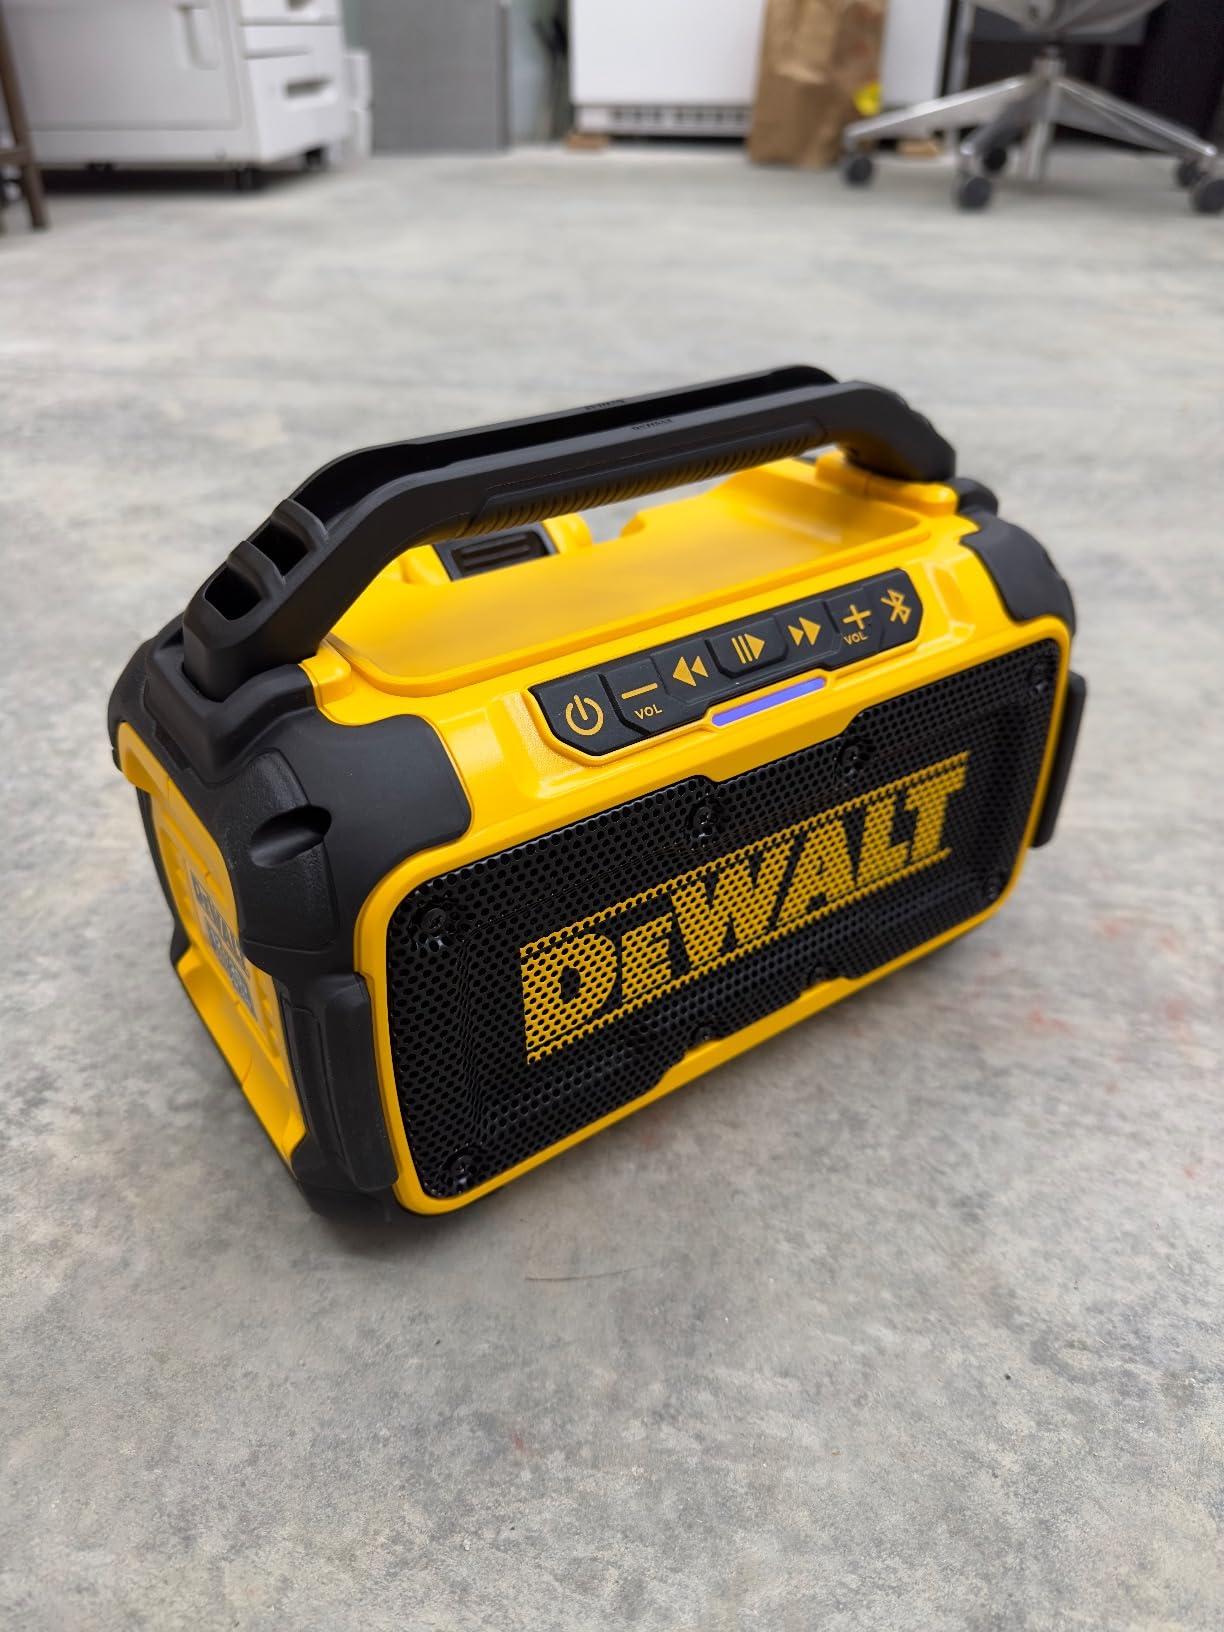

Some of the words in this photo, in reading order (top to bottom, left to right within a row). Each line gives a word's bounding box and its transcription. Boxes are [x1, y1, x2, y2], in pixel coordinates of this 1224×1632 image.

[843, 632, 868, 645] VOL
[634, 704, 663, 720] VOL
[519, 751, 969, 1065] DEWALT
